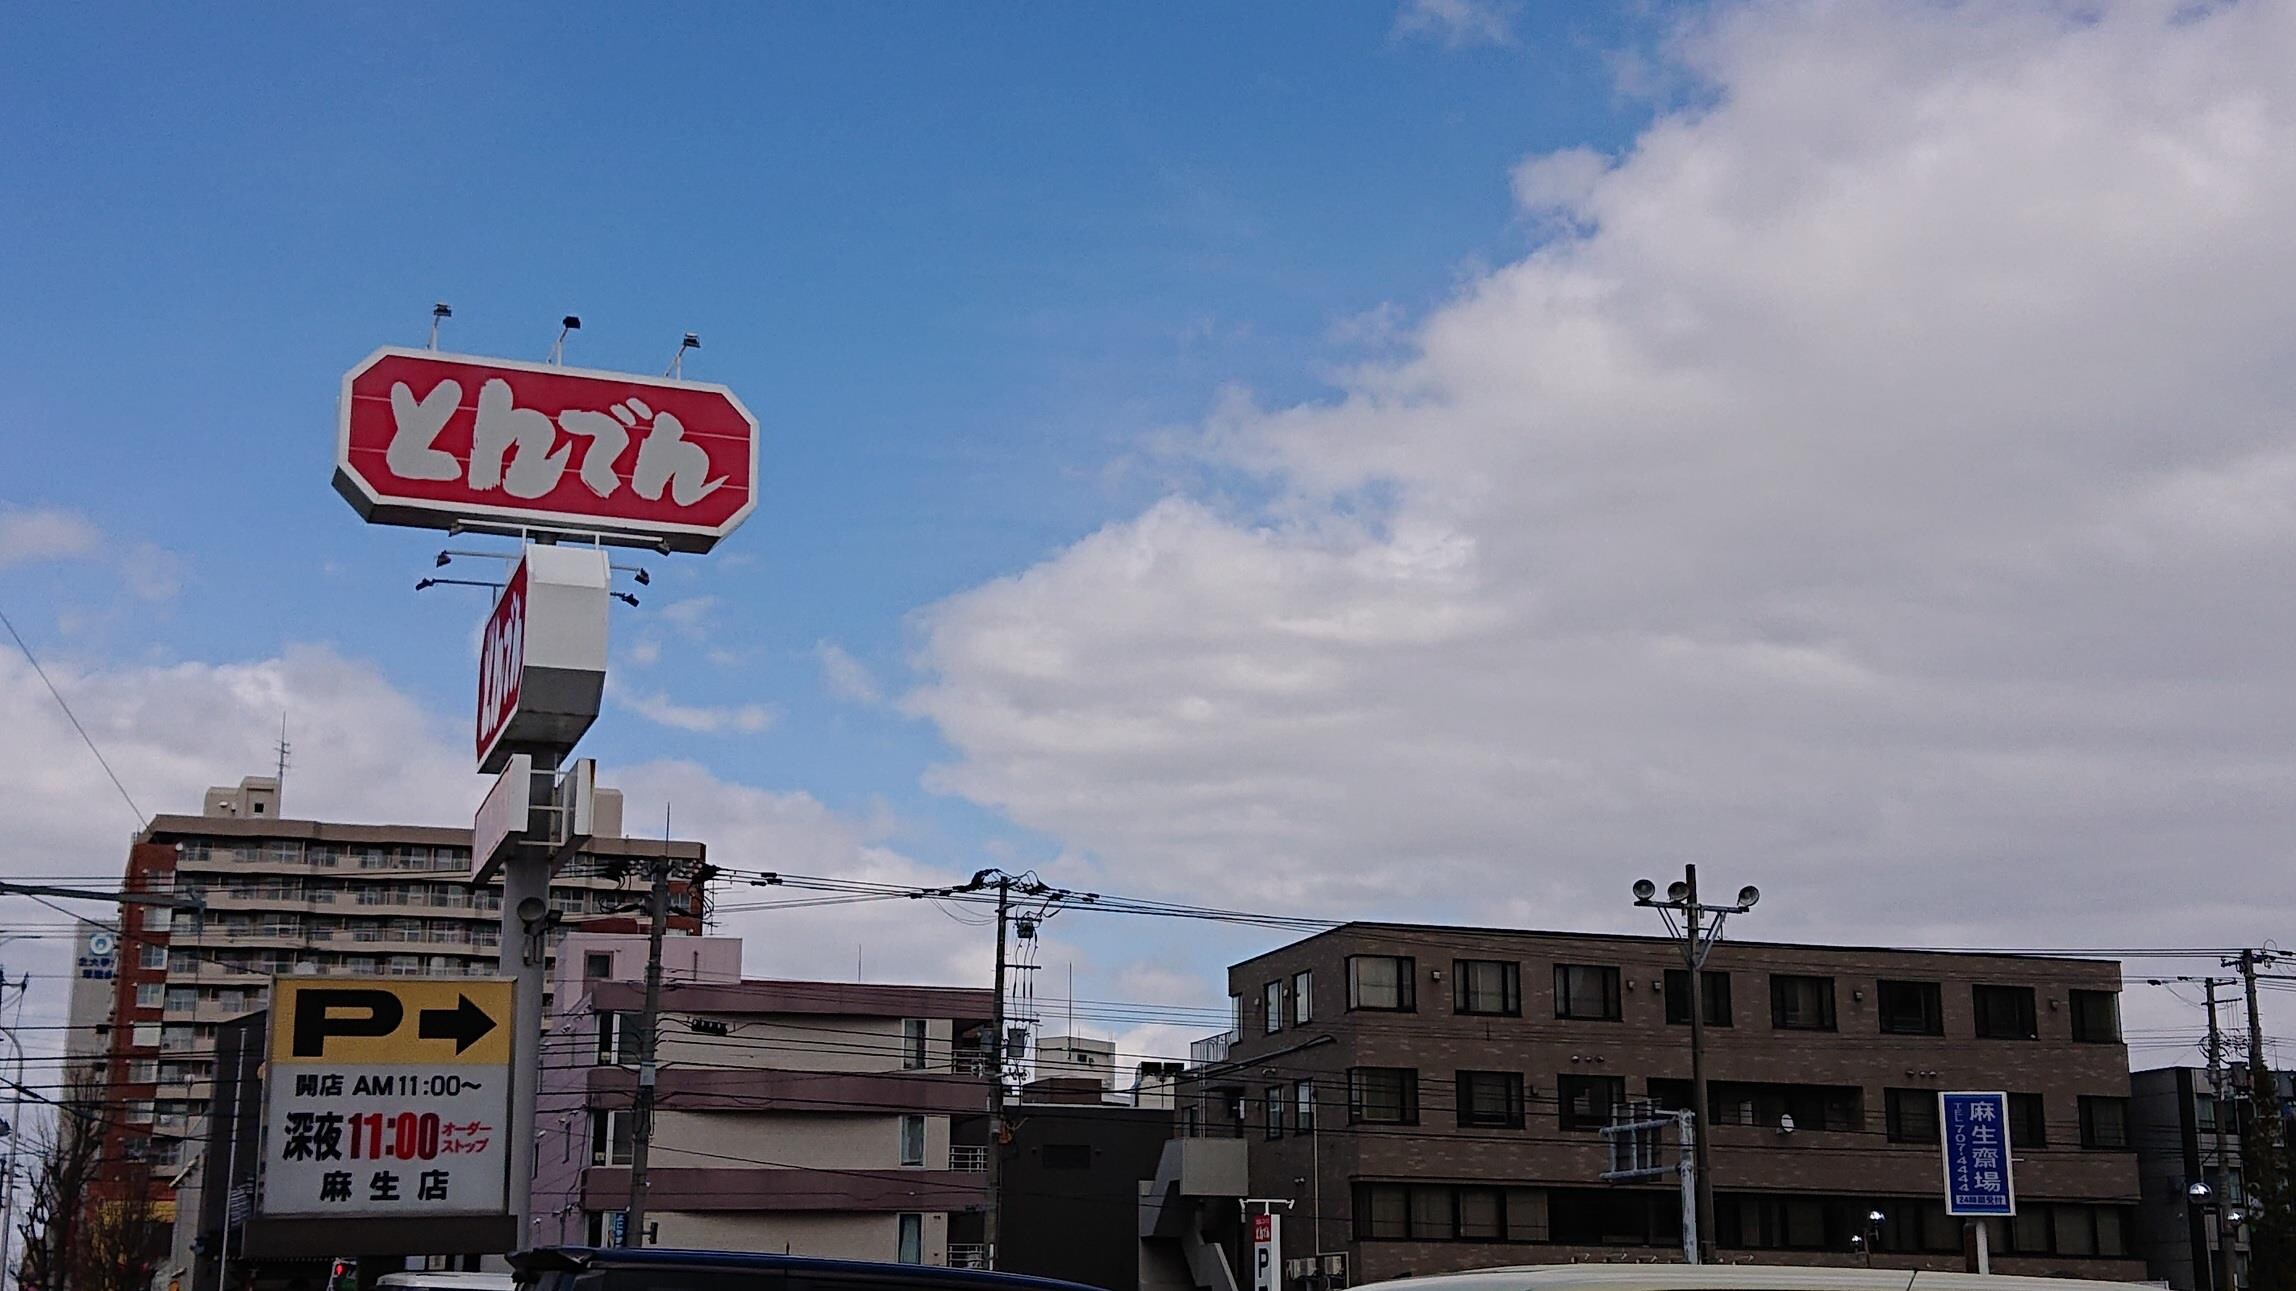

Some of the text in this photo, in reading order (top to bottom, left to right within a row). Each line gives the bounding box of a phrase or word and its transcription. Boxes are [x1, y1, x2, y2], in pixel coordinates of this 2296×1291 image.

[386, 378, 730, 507] とんでん
[292, 988, 404, 1057] P
[295, 1074, 344, 1097] 開店
[283, 1111, 441, 1161] 深夜 11:00
[441, 1138, 490, 1153] ストップ
[442, 1121, 492, 1136] オーダー
